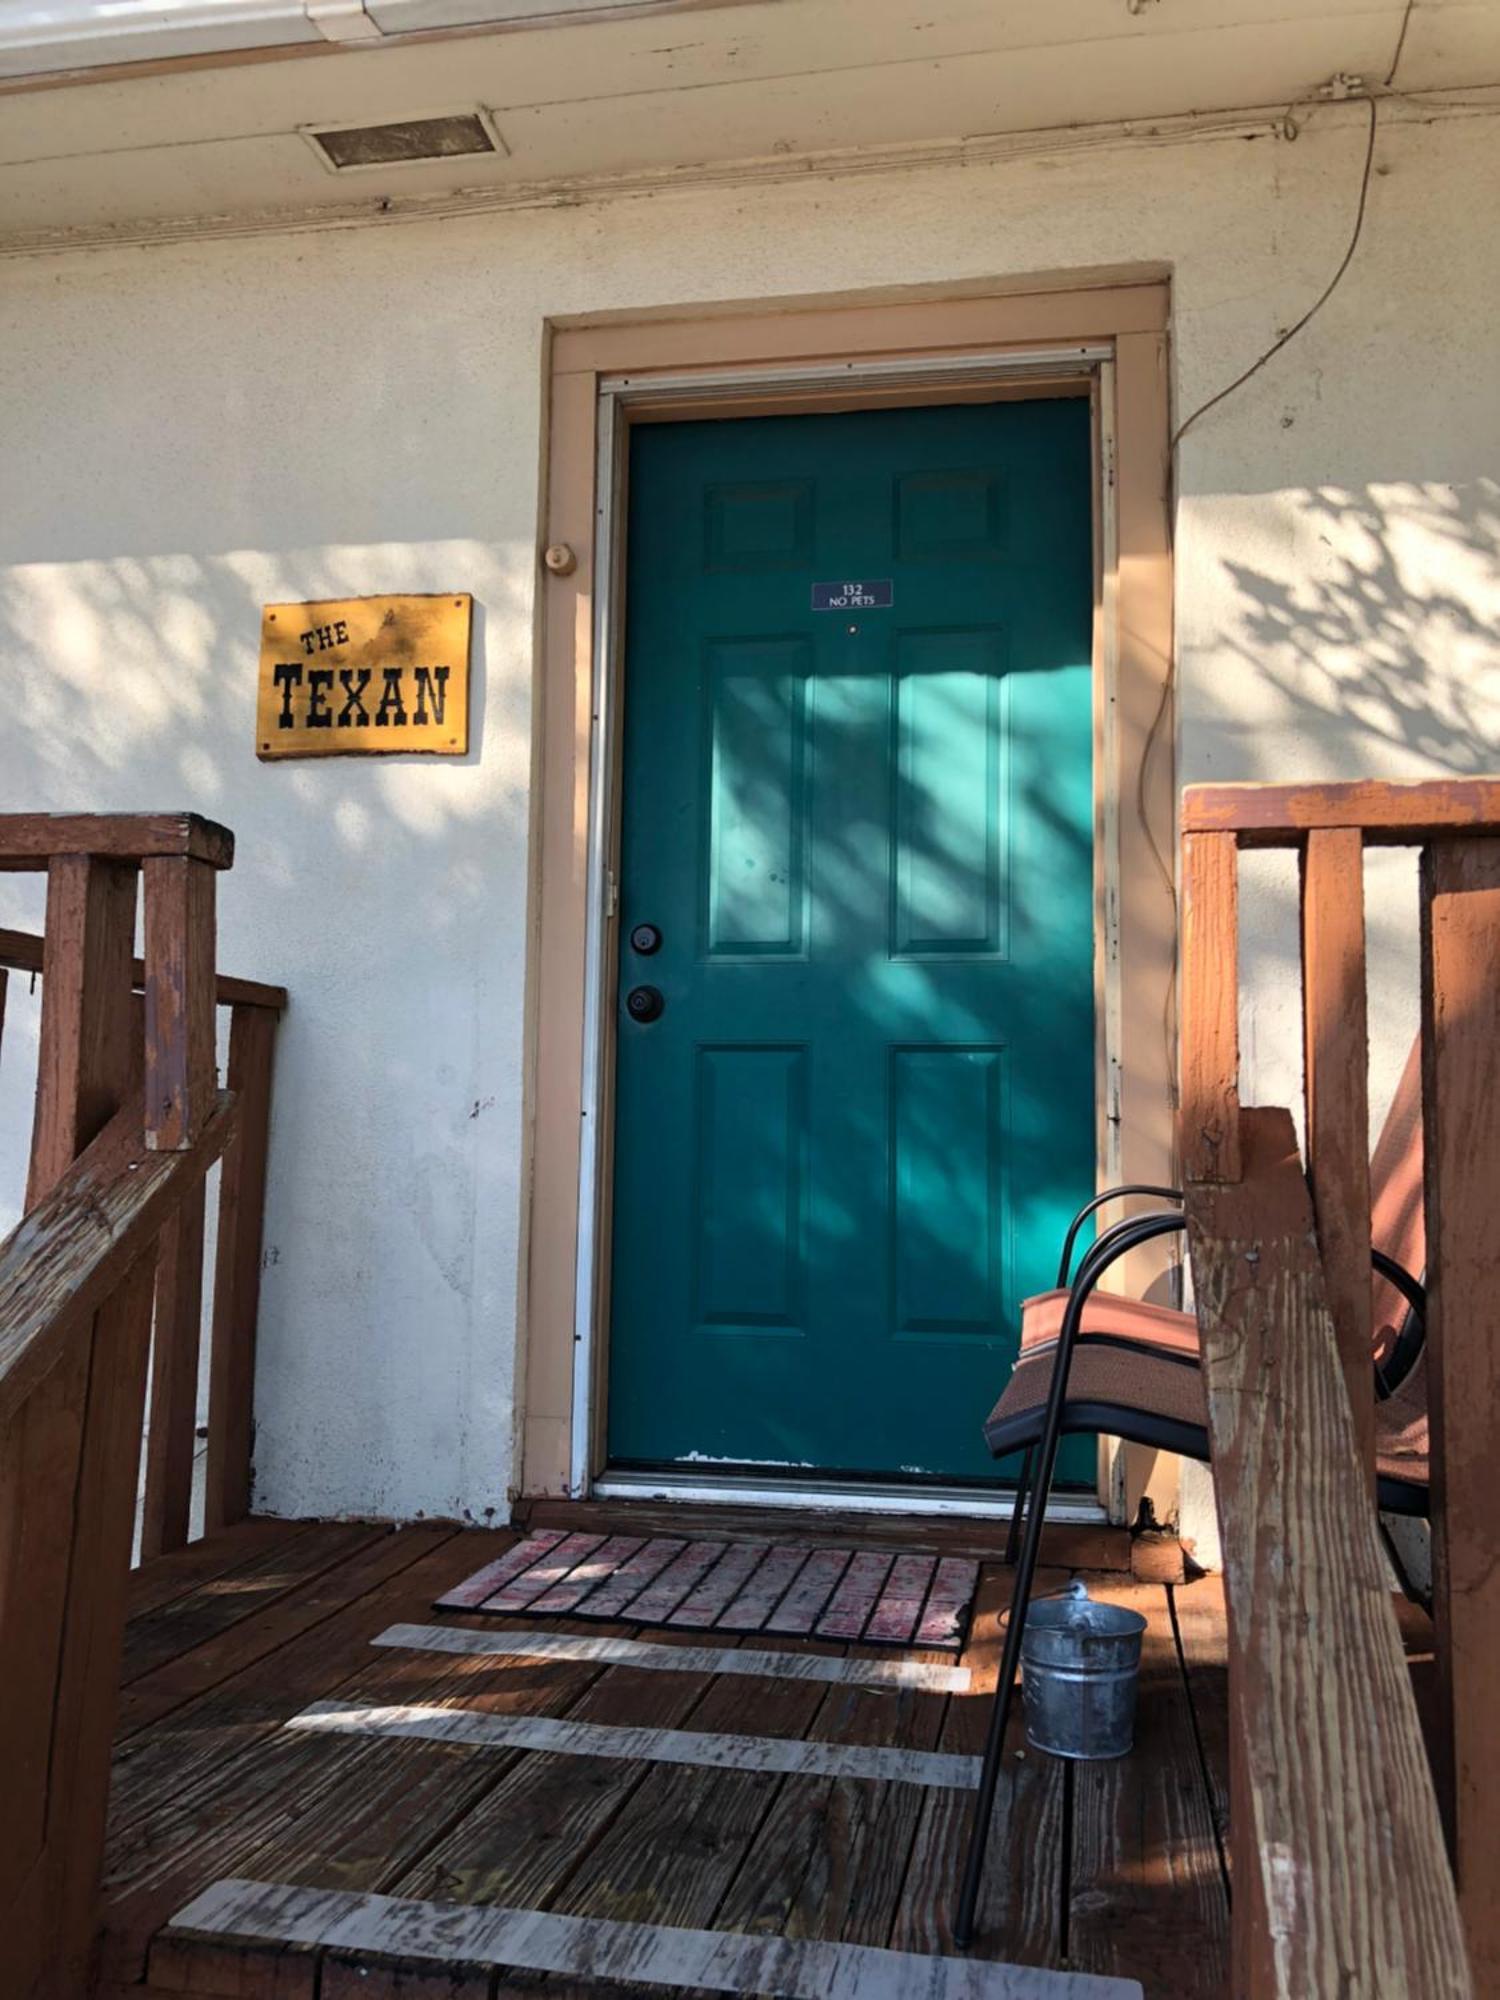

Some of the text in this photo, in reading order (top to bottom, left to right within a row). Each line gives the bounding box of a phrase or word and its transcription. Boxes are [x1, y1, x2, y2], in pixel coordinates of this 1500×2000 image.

[829, 595, 875, 607] NO PETS
[843, 584, 863, 596] 132
[300, 620, 349, 655] THE
[273, 663, 450, 729] TEXAN
